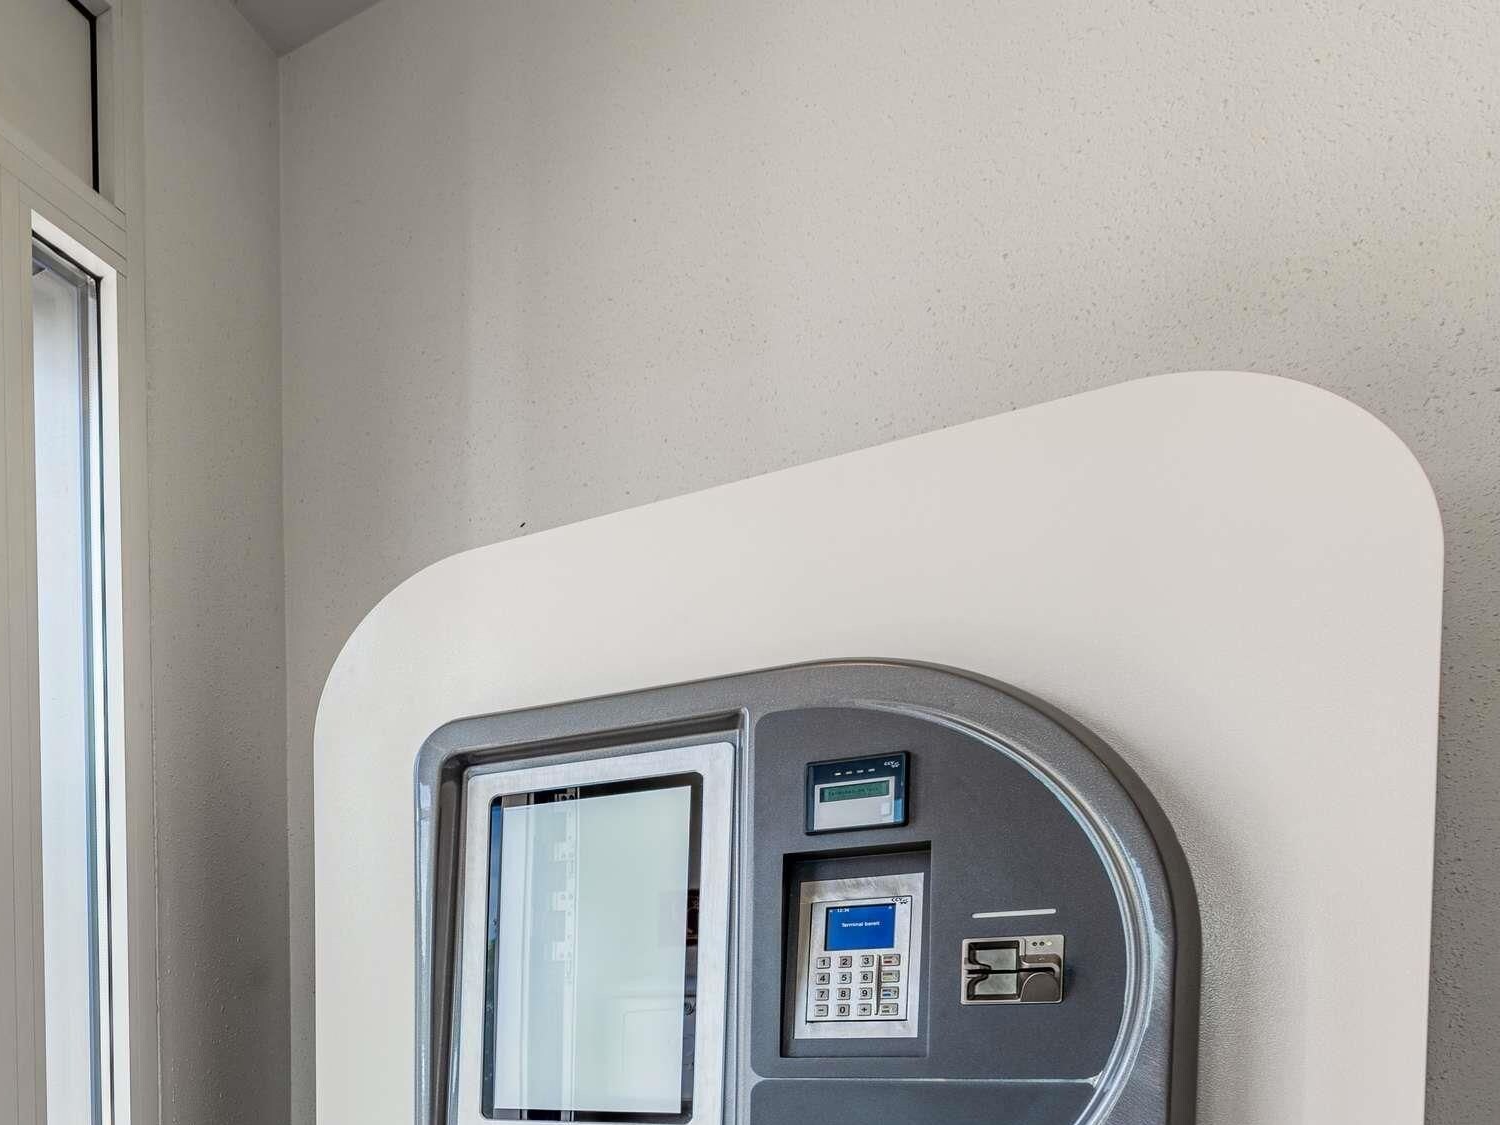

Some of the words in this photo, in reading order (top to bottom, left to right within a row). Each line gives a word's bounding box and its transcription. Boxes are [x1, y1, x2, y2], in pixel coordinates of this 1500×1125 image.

[842, 958, 848, 966] 2
[864, 957, 870, 965] 3
[841, 974, 847, 982] 5
[862, 973, 869, 981] 6
[840, 990, 846, 998] 8
[861, 989, 868, 997] 9
[839, 1006, 846, 1014] 0
